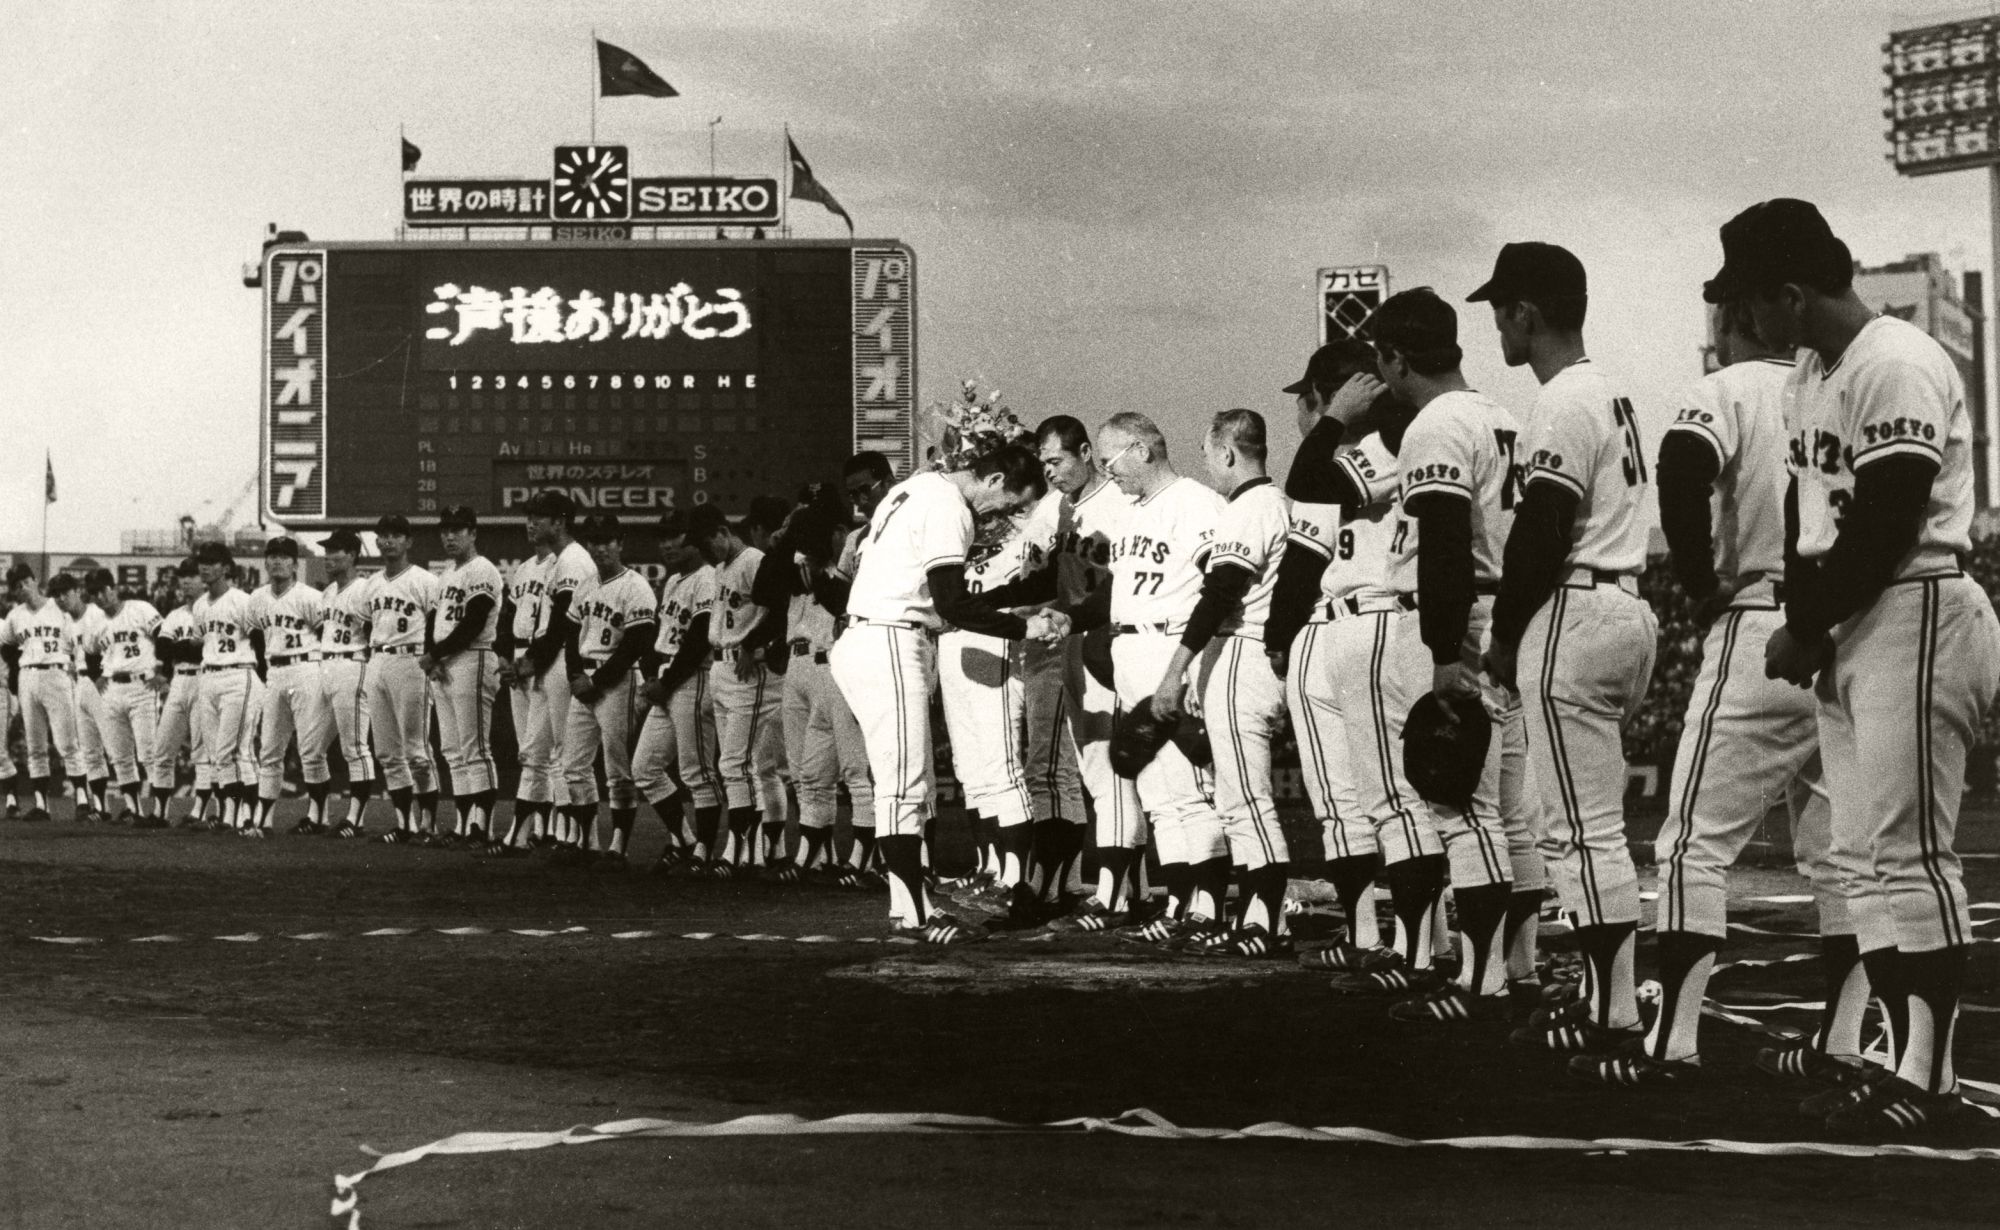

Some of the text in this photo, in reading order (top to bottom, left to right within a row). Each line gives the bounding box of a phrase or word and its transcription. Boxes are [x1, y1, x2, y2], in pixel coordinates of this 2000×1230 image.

[410, 187, 546, 213] 世界の時計
[639, 185, 769, 212] SEIKO
[556, 226, 626, 241] SEIKO
[1324, 270, 1379, 289] カセ
[425, 282, 752, 345] ご声援ありがとう
[275, 260, 321, 507] パイオニア
[449, 375, 756, 389] 1 2 3 4 5 6 7 8 9 10 R H E
[1863, 417, 1936, 444] TOKYO
[694, 445, 706, 459] S
[526, 464, 654, 481] 世界のステレオ
[694, 467, 706, 482] B
[1406, 464, 1460, 485] TOKYO
[1338, 529, 1355, 560] 9
[1132, 571, 1164, 596] 77
[445, 605, 464, 621] 20
[285, 633, 303, 649] 21
[333, 629, 351, 645] 36
[600, 628, 612, 646] 8
[43, 641, 59, 653] 52
[218, 639, 235, 653] 29
